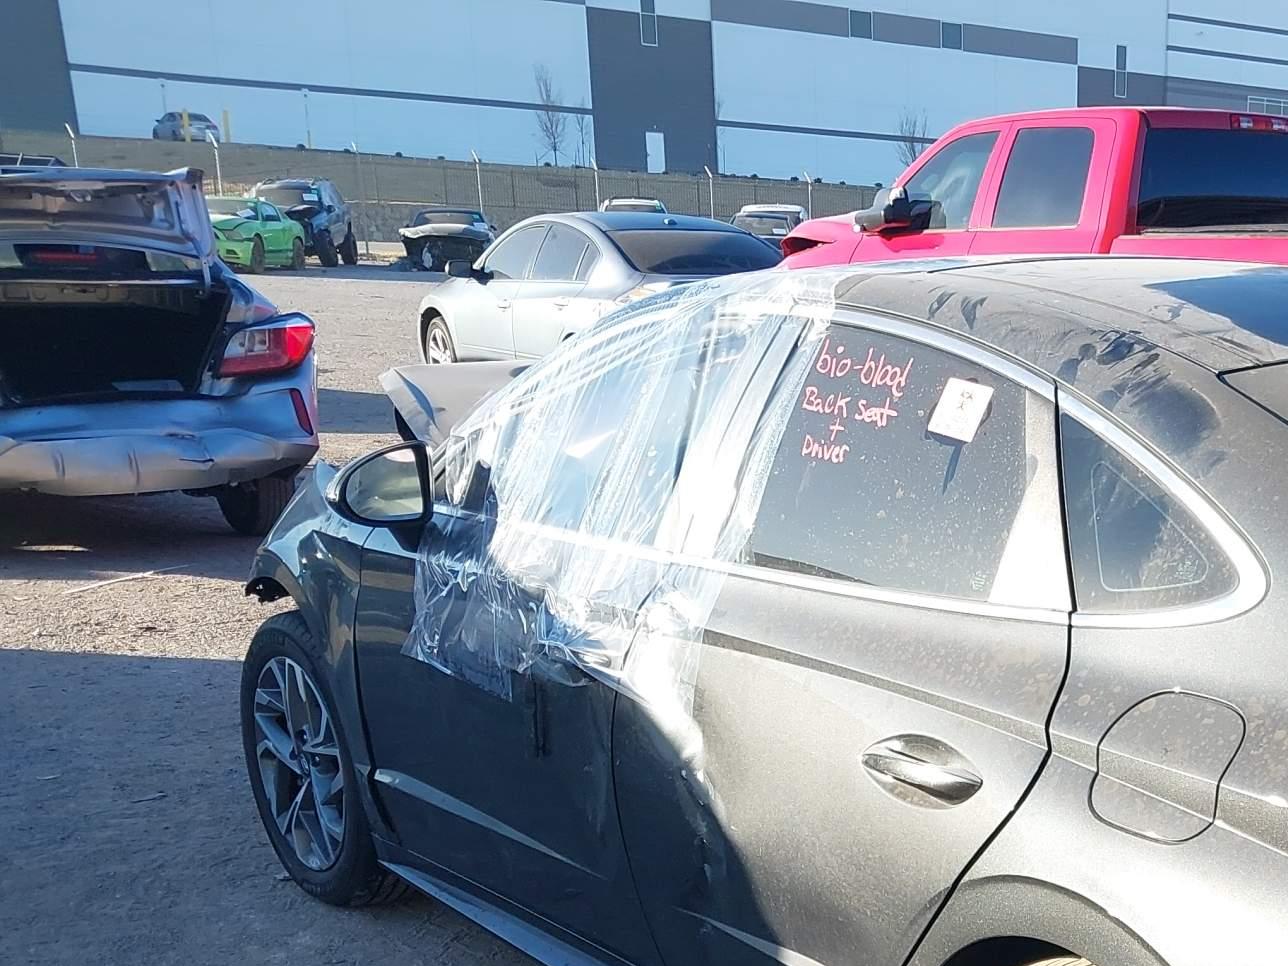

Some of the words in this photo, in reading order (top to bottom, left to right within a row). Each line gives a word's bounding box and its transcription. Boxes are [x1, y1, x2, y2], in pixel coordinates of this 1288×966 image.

[816, 338, 914, 397] bio-blood
[829, 417, 844, 441] +
[802, 434, 850, 463] Driver
